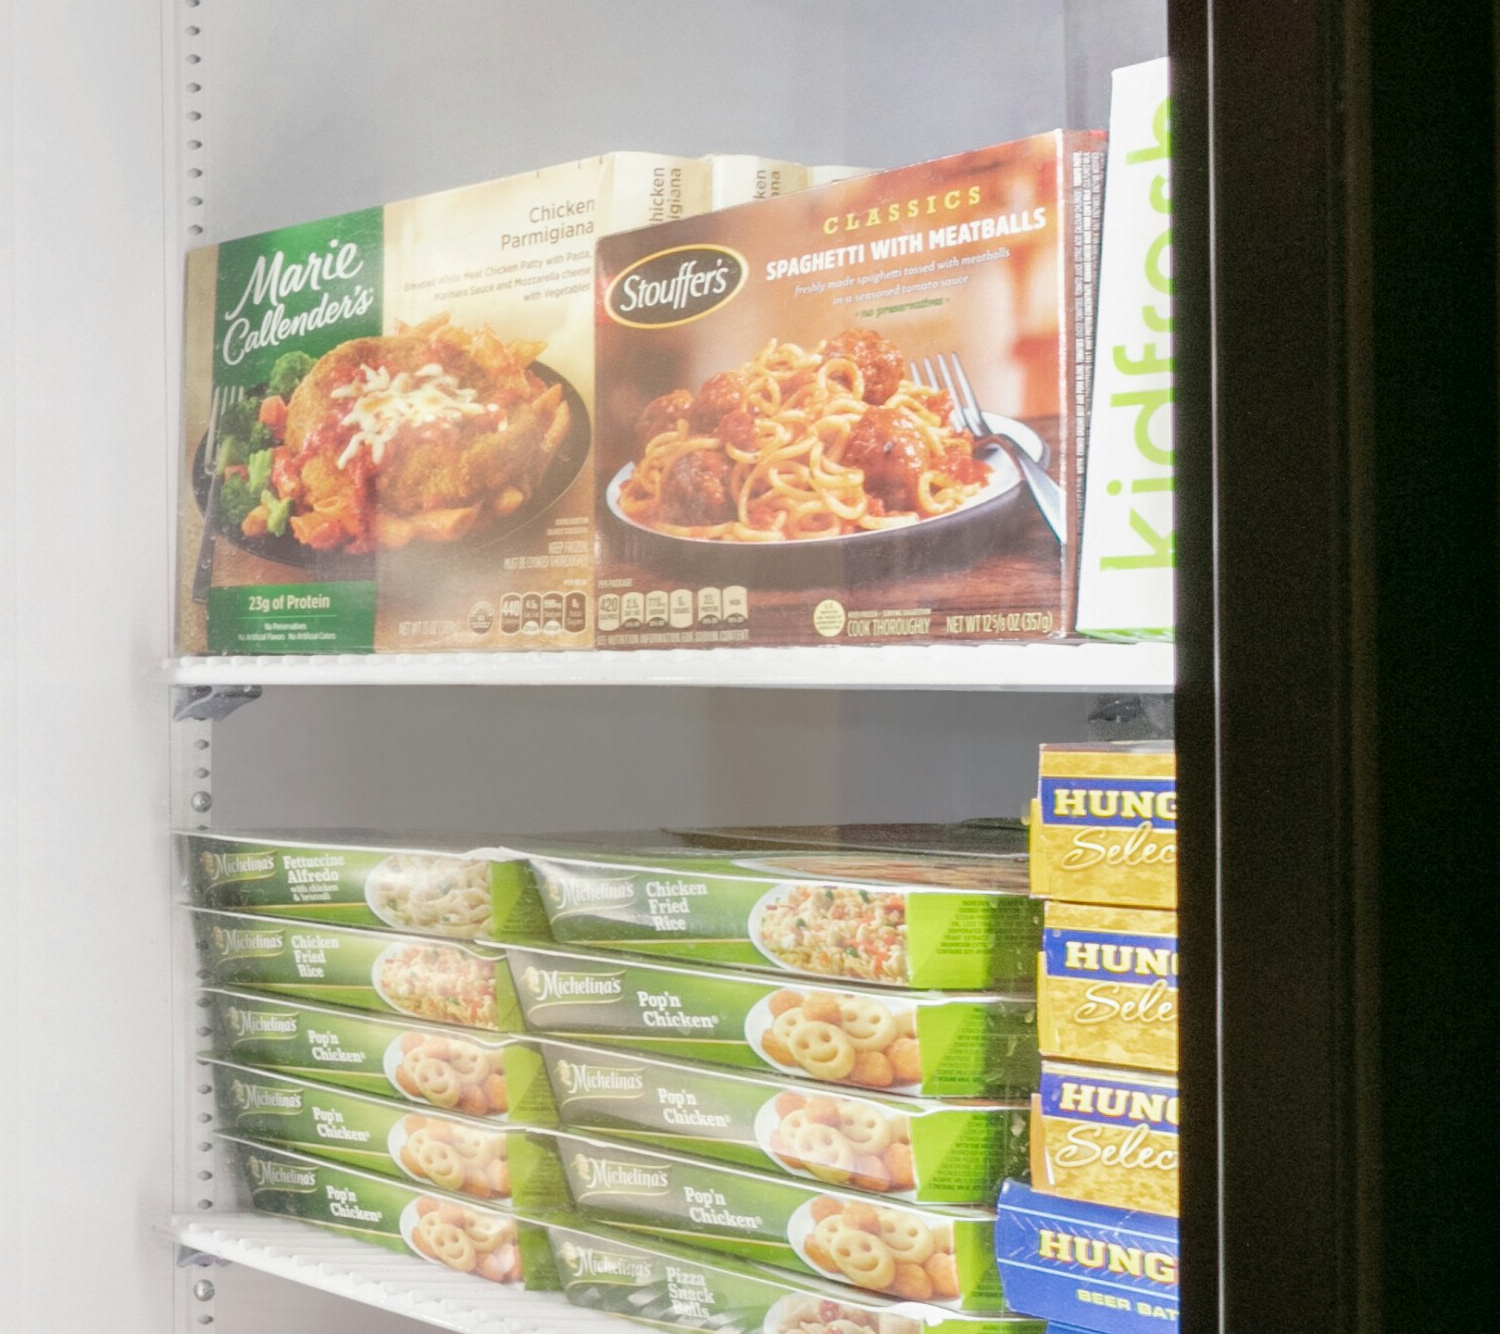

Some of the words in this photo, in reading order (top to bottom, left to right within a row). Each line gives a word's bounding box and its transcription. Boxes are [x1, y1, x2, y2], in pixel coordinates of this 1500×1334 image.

[528, 198, 595, 224] Chicken
[822, 185, 983, 236] CLASSICS
[500, 219, 595, 251] Parmigiana
[765, 245, 865, 282] SPAGHETTI
[870, 235, 923, 262] WITH
[928, 207, 1048, 249] MEATBALLS
[225, 238, 364, 321] Marie
[619, 258, 729, 312] Stouffer's
[794, 279, 825, 299] freshly
[827, 275, 855, 290] made
[857, 268, 902, 287] spaghetti
[936, 258, 960, 273] with
[961, 247, 1011, 269] meatballs
[222, 284, 374, 366] Callender's
[248, 596, 270, 614] 23g
[271, 595, 285, 611] of
[286, 594, 331, 611] Protein
[847, 618, 872, 637] COOK
[872, 616, 930, 636] THOROUGHLY
[211, 854, 274, 880] Michelina's
[283, 855, 345, 869] Fettuccine
[287, 870, 339, 884] Alfredo
[645, 881, 708, 898] Chicken
[648, 898, 690, 915] Fried
[652, 917, 687, 931] Rice
[222, 929, 283, 955] Michelina's
[291, 936, 340, 949] Chicken
[294, 950, 326, 964] Fried
[297, 964, 325, 978] Rice
[537, 969, 622, 1001] Michelina's
[637, 991, 682, 1011] Pop'n
[568, 1063, 644, 1095] Michelina's
[585, 1157, 669, 1189] Michelina's
[683, 1186, 726, 1208] Pop'n
[1039, 1229, 1177, 1284] HUNG
[666, 1266, 706, 1286] Pizza
[668, 1283, 716, 1305] Snack
[1076, 1287, 1132, 1312] BEER
